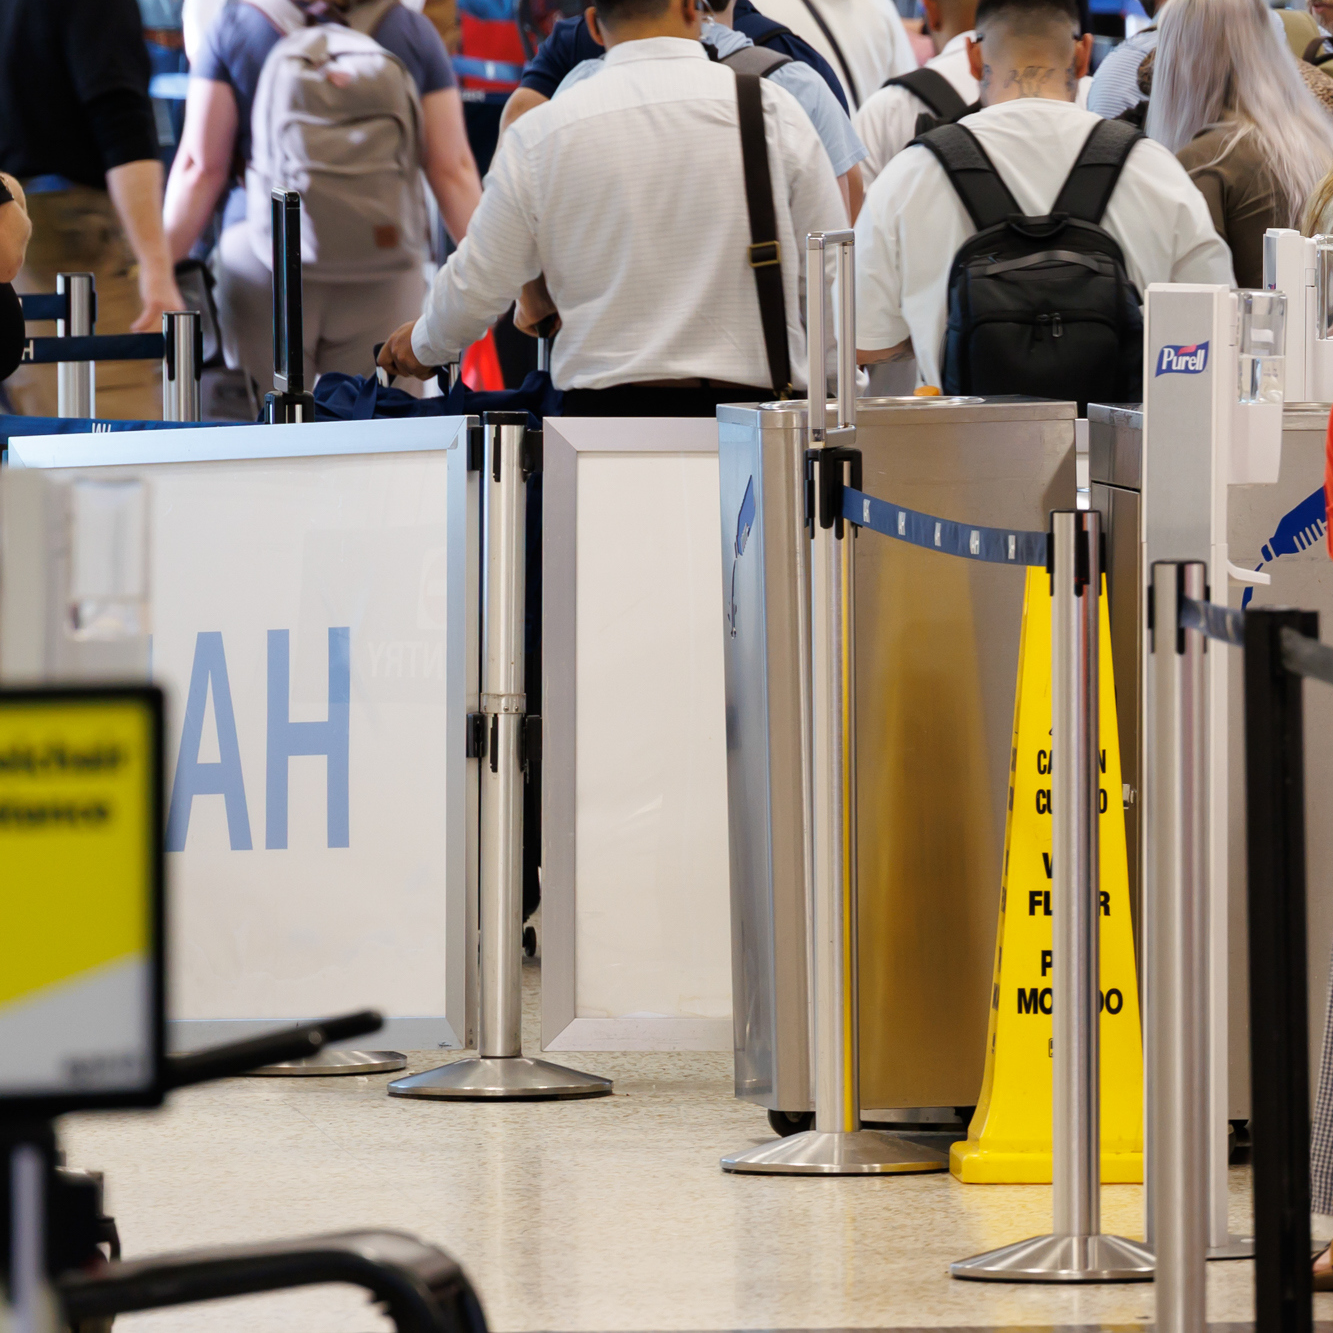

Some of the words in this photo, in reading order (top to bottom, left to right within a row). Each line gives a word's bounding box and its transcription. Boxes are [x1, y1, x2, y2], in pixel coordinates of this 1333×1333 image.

[1161, 347, 1206, 371] Purell
[148, 626, 351, 853] AH
[1028, 890, 1111, 917] FLR
